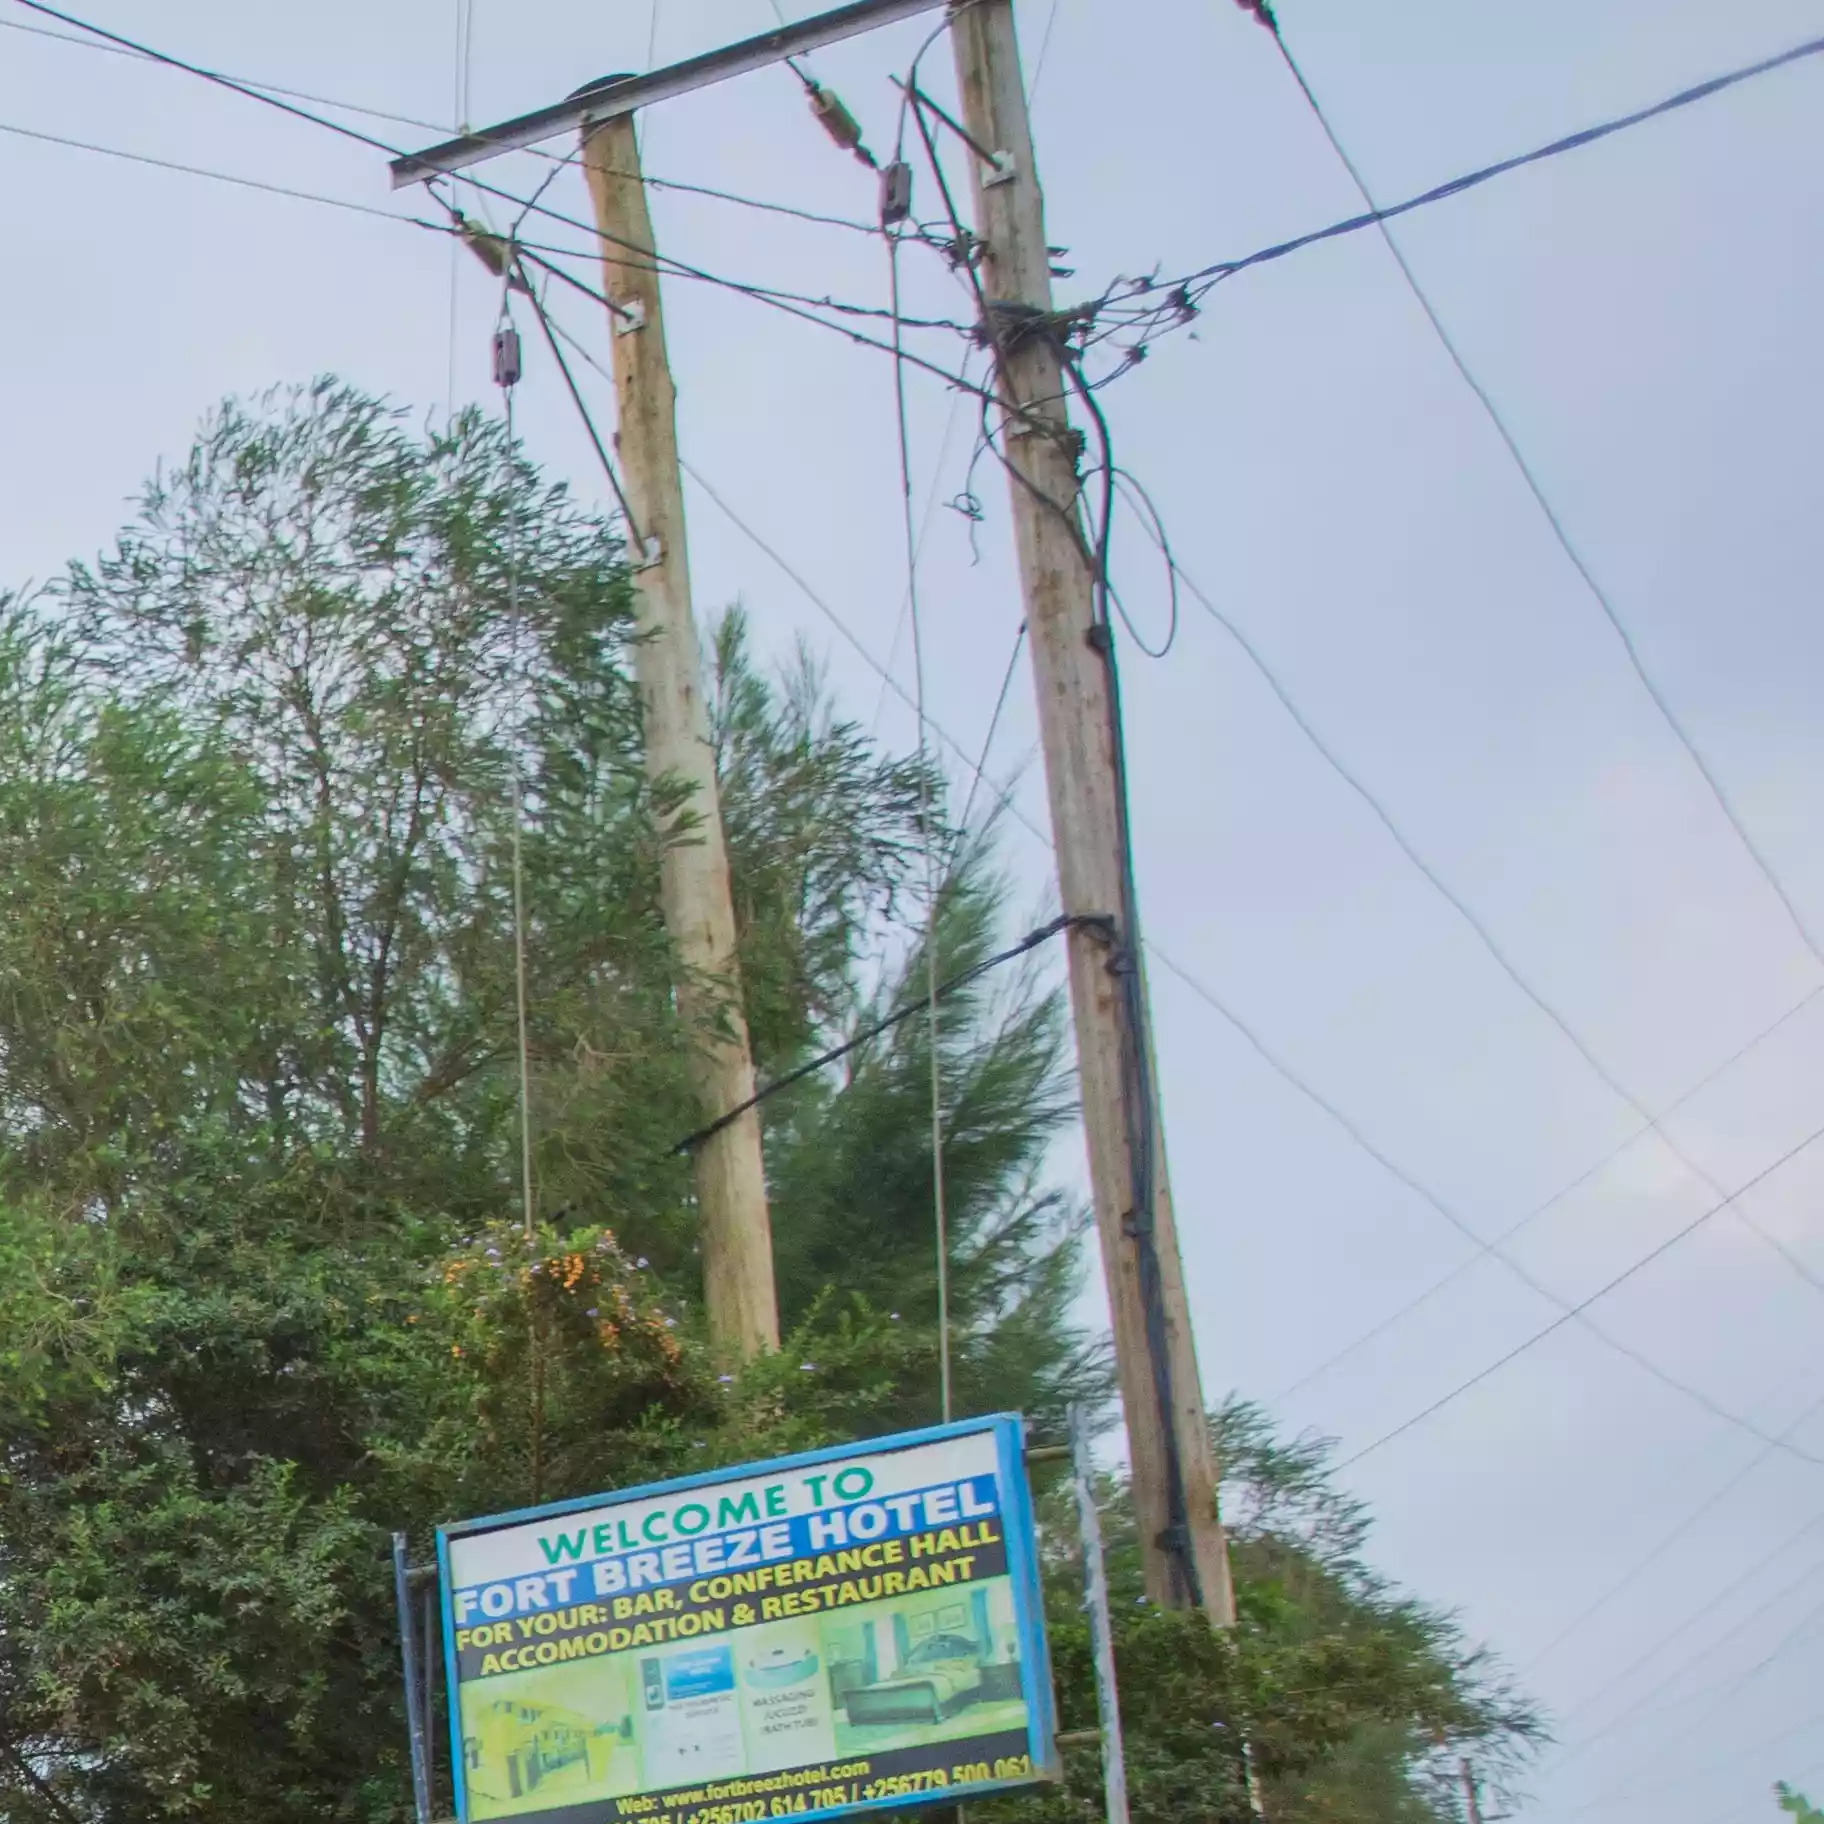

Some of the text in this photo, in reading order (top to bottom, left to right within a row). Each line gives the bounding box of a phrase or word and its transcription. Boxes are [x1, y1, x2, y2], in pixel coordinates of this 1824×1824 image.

[455, 1483, 995, 1624] FORT BREEZE HOTEL
[538, 1467, 874, 1565] WELCOME TO
[456, 1521, 1000, 1650] FOR YOUR: BAR, CONFERANCE HALL
[479, 1556, 976, 1675] ACCOMODATION & RESTAURANT
[616, 1761, 870, 1816] Web: www.fortbreezhotel.com
[770, 1792, 807, 1818] 614
[809, 1784, 848, 1811] 705
